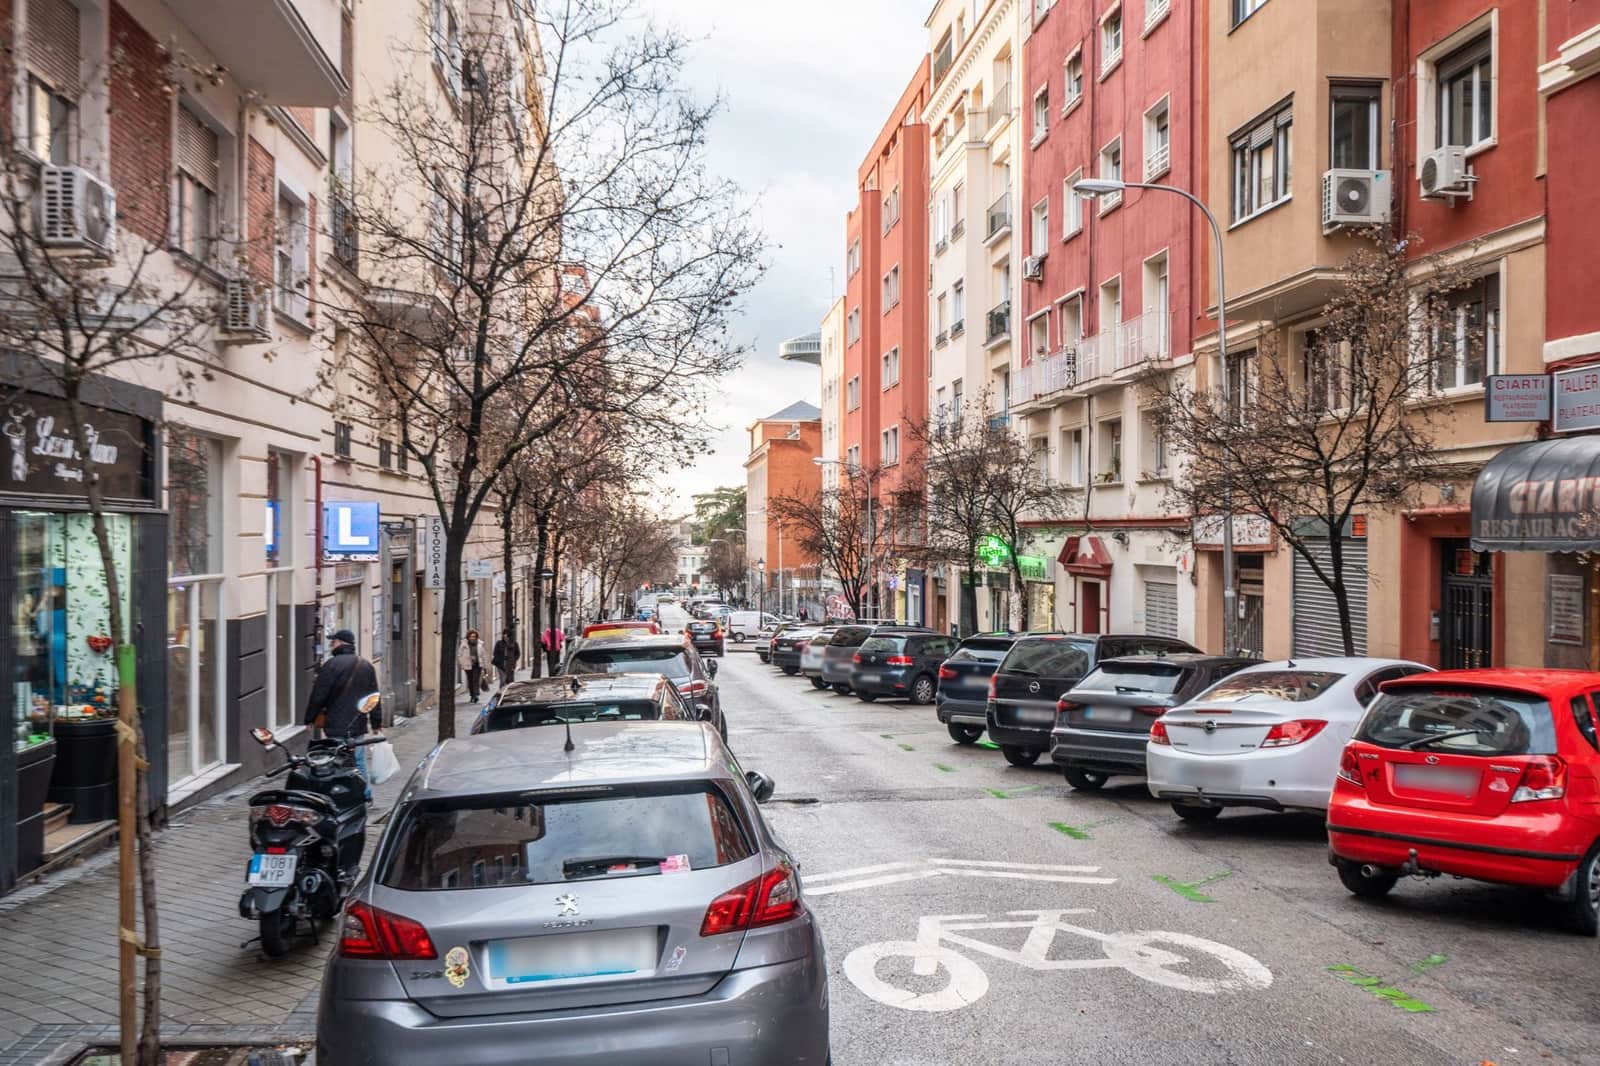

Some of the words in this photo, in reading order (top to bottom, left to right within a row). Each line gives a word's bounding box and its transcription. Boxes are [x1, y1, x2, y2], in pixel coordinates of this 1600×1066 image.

[1495, 379, 1545, 390] CIARTI
[339, 507, 369, 545] L
[432, 518, 440, 586] FOTOCOPIAS
